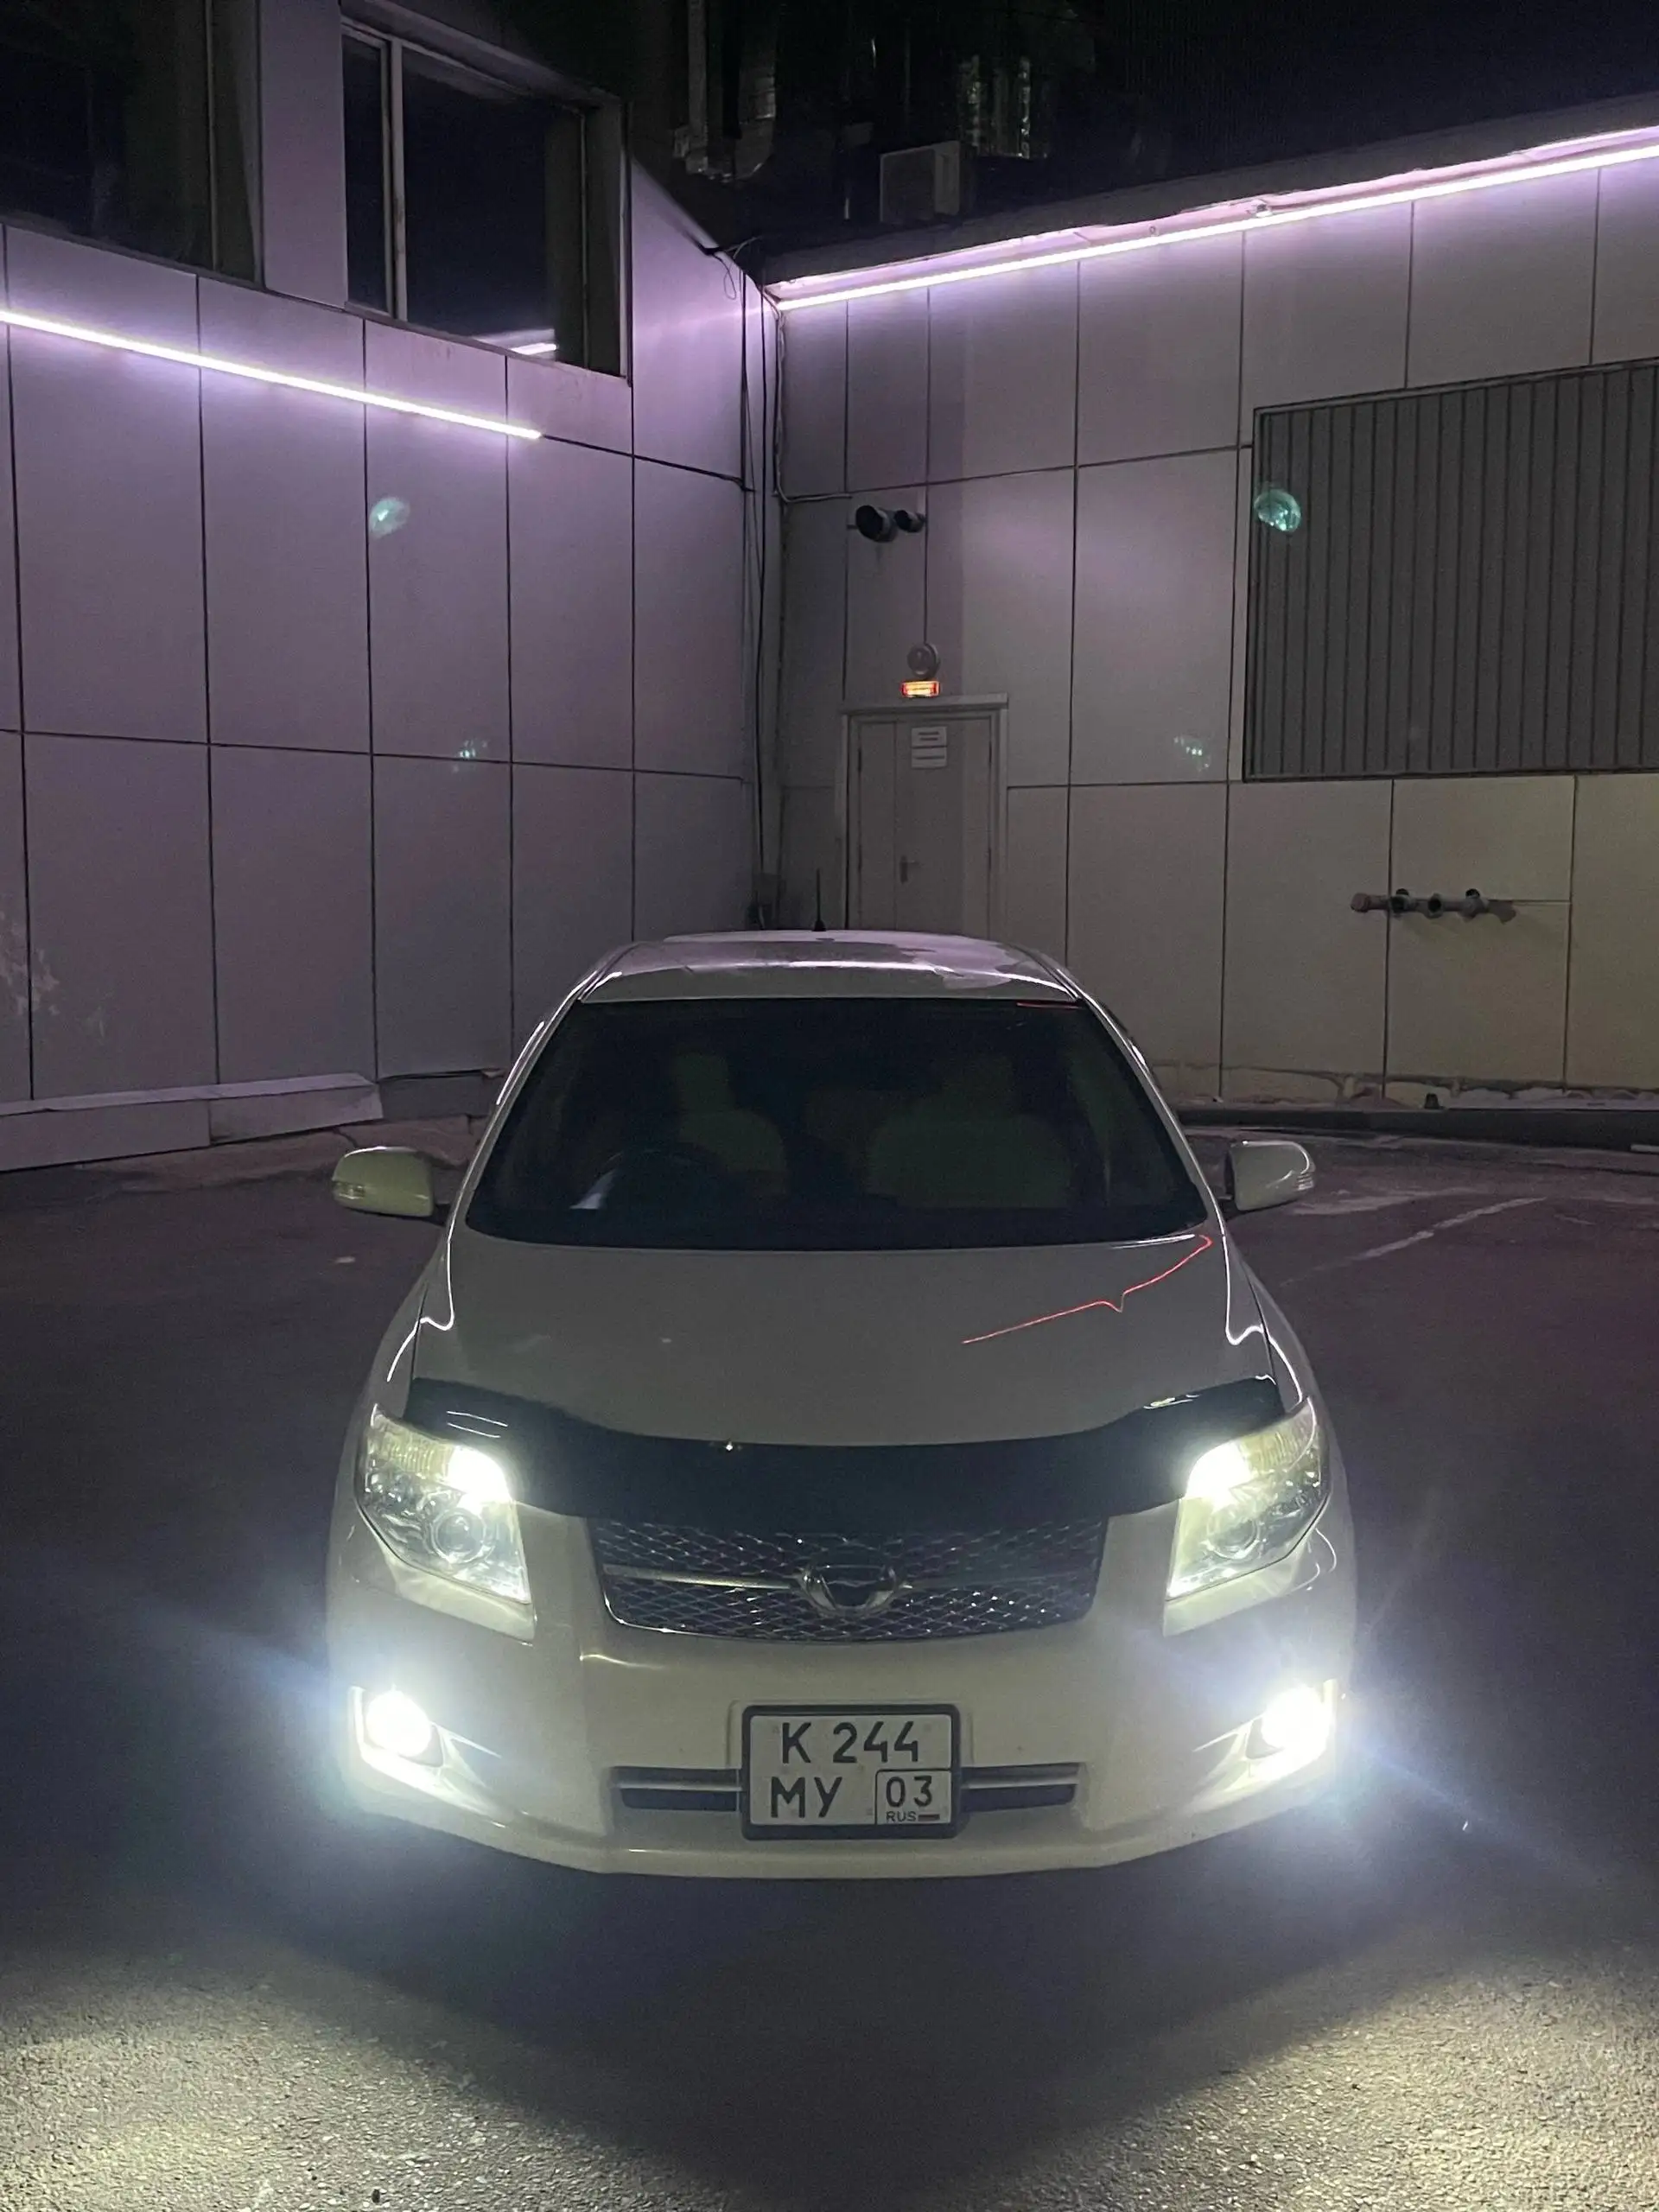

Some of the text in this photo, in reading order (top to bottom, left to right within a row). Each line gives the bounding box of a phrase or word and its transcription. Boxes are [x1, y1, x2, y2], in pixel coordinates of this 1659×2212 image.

[782, 1721, 918, 1764] К 244
[886, 1776, 932, 1807] 03
[886, 1811, 916, 1821] RUS
